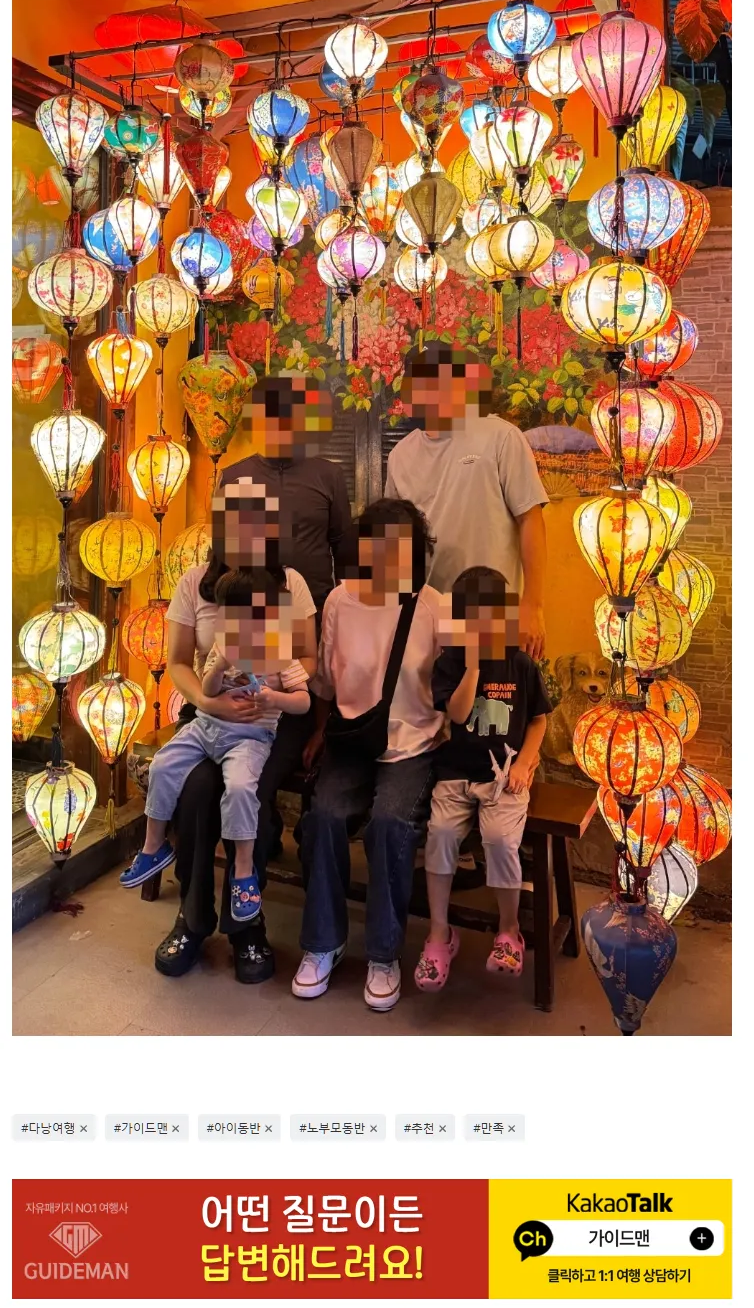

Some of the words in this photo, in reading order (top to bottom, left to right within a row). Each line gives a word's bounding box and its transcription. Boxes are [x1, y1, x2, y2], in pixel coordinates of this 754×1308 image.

[20, 1122, 75, 1135] #다낭여행
[113, 1122, 168, 1135] #가이드맨
[206, 1122, 261, 1135] #아이동반
[299, 1122, 365, 1135] #노부모동반
[403, 1122, 434, 1135] #추천
[472, 1122, 505, 1135] #만족
[25, 1201, 74, 1215] 자유패키지
[75, 1202, 97, 1214] NO.1
[98, 1201, 129, 1215] 여행사
[567, 1192, 674, 1213] KakaoTalk
[202, 1195, 269, 1232] 어떤
[283, 1195, 423, 1233] 질문이든
[518, 1230, 547, 1248] Ch
[588, 1228, 650, 1248] 가이드맨
[201, 1243, 423, 1282] 답변해드려요!
[24, 1262, 129, 1280] GUIDEMAN
[547, 1268, 596, 1284] 클릭하고
[598, 1269, 614, 1283] 1:1
[616, 1268, 641, 1284] 여행
[642, 1268, 692, 1284] 상담하기
